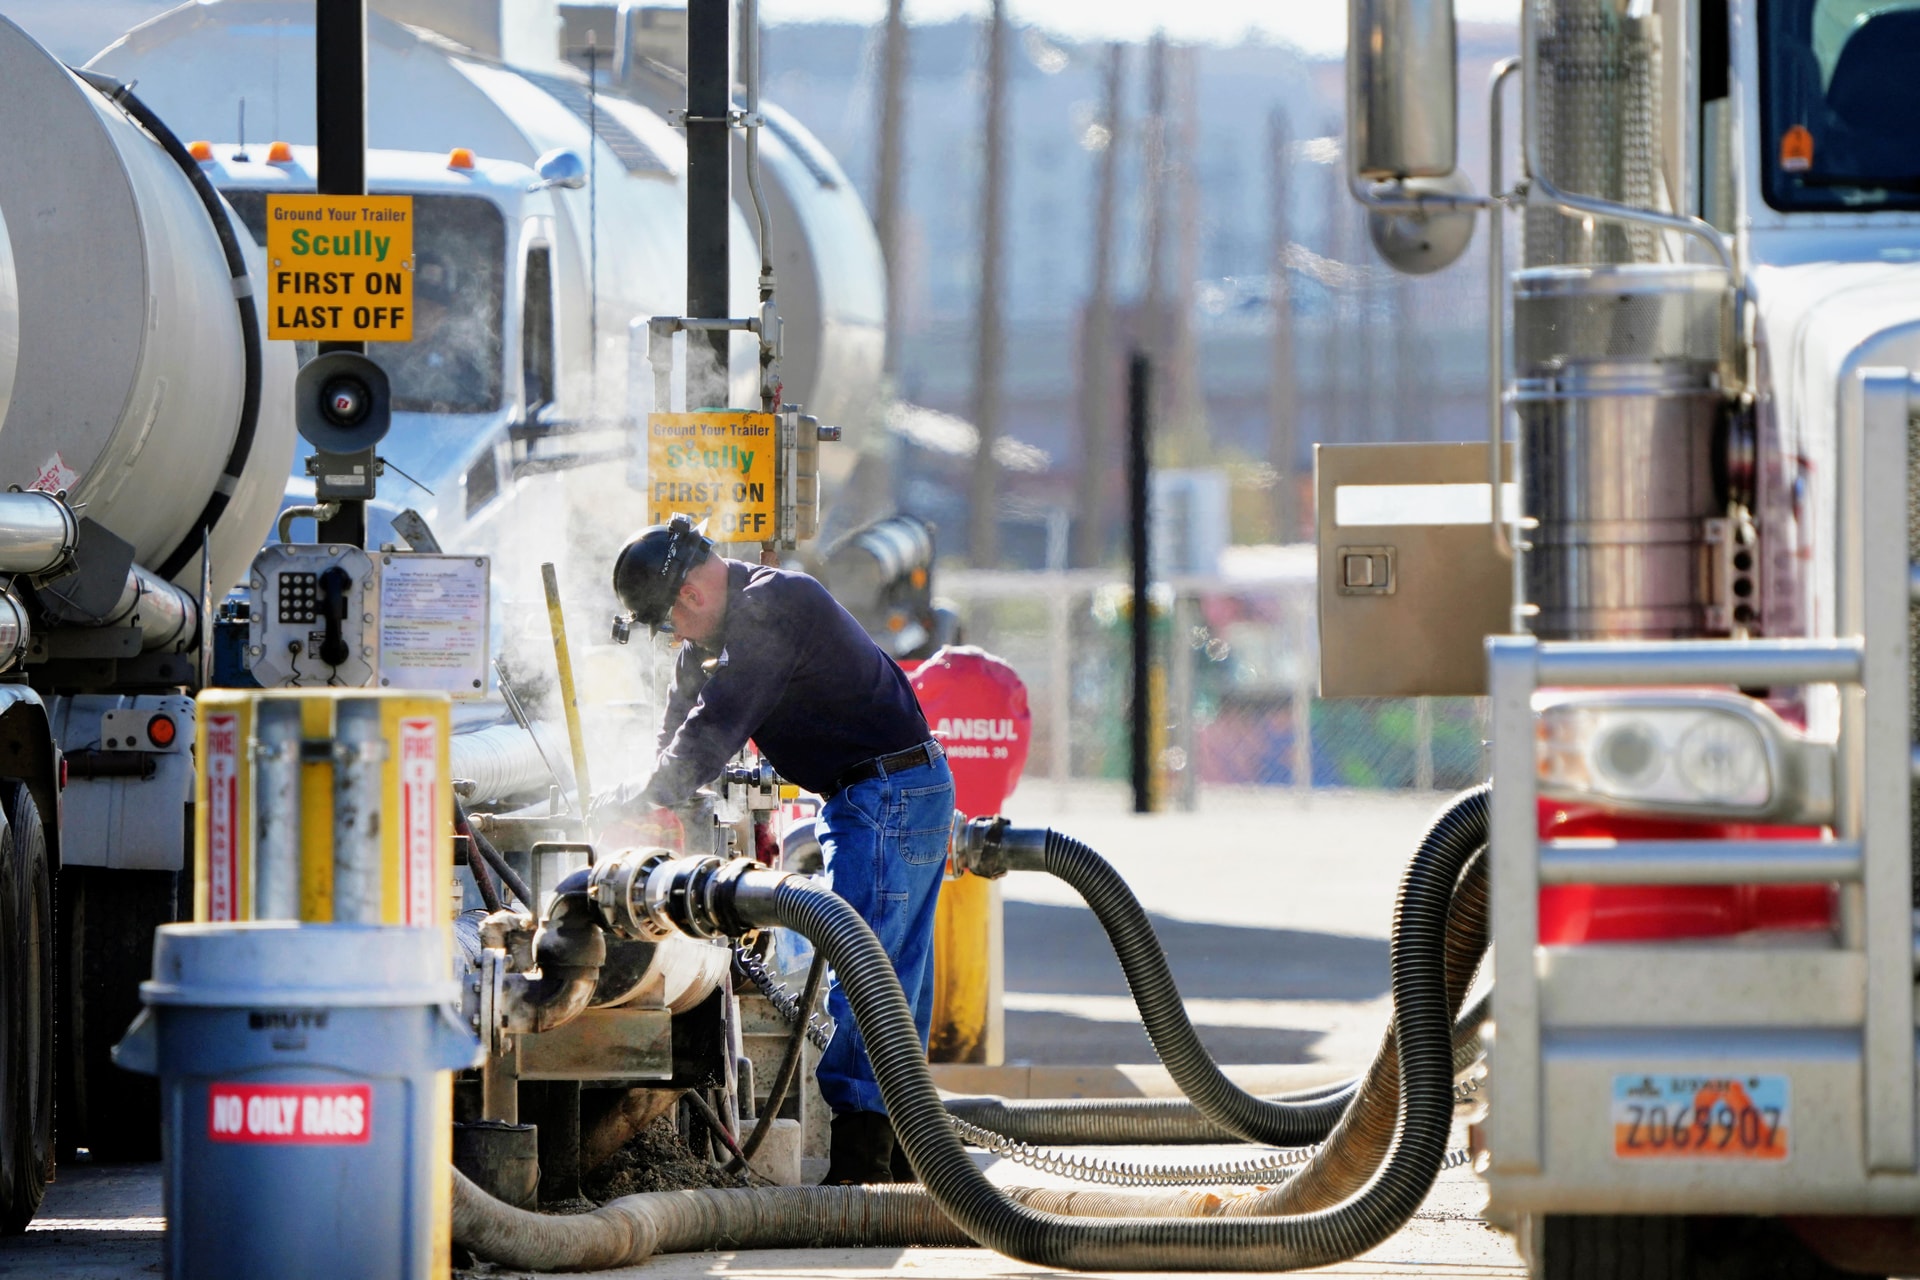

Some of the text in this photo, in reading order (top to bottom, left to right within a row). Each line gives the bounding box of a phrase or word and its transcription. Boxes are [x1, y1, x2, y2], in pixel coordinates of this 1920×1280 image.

[274, 207, 406, 222] Ground Your Trailer
[291, 228, 391, 262] Scully
[277, 272, 402, 295] FIRST ON
[277, 306, 405, 329] LAST OFF
[654, 423, 770, 436] Ground Your Trailer
[667, 445, 754, 474] Scully
[655, 482, 764, 503] FIRST ON
[721, 513, 767, 533] OFF
[937, 717, 1018, 741] ANSUL
[947, 745, 990, 758] MODEL
[213, 1095, 365, 1135] NO OILY RAGS
